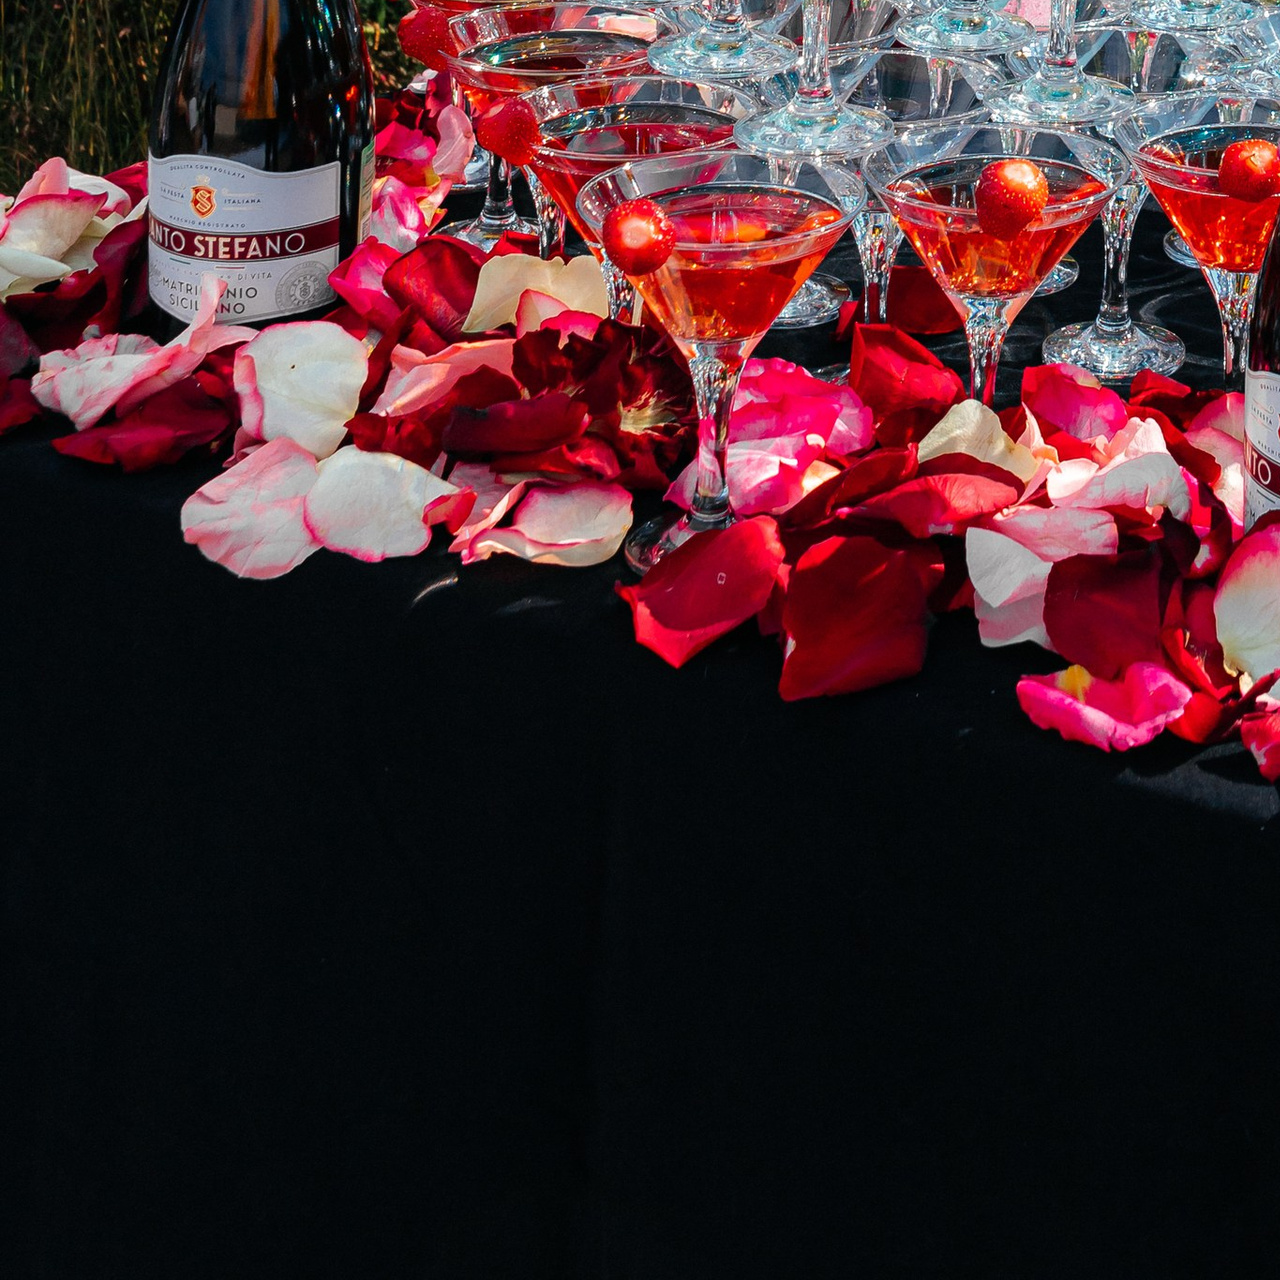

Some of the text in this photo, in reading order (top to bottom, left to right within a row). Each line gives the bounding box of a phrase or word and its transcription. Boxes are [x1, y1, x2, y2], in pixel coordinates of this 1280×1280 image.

[195, 164, 246, 179] CONTROLLATA
[198, 221, 246, 229] REGISTRATO
[149, 215, 306, 260] ANTO STEFANO
[250, 272, 273, 280] VITA
[162, 277, 258, 299] MATRINIO
[169, 293, 246, 315] SICILNO
